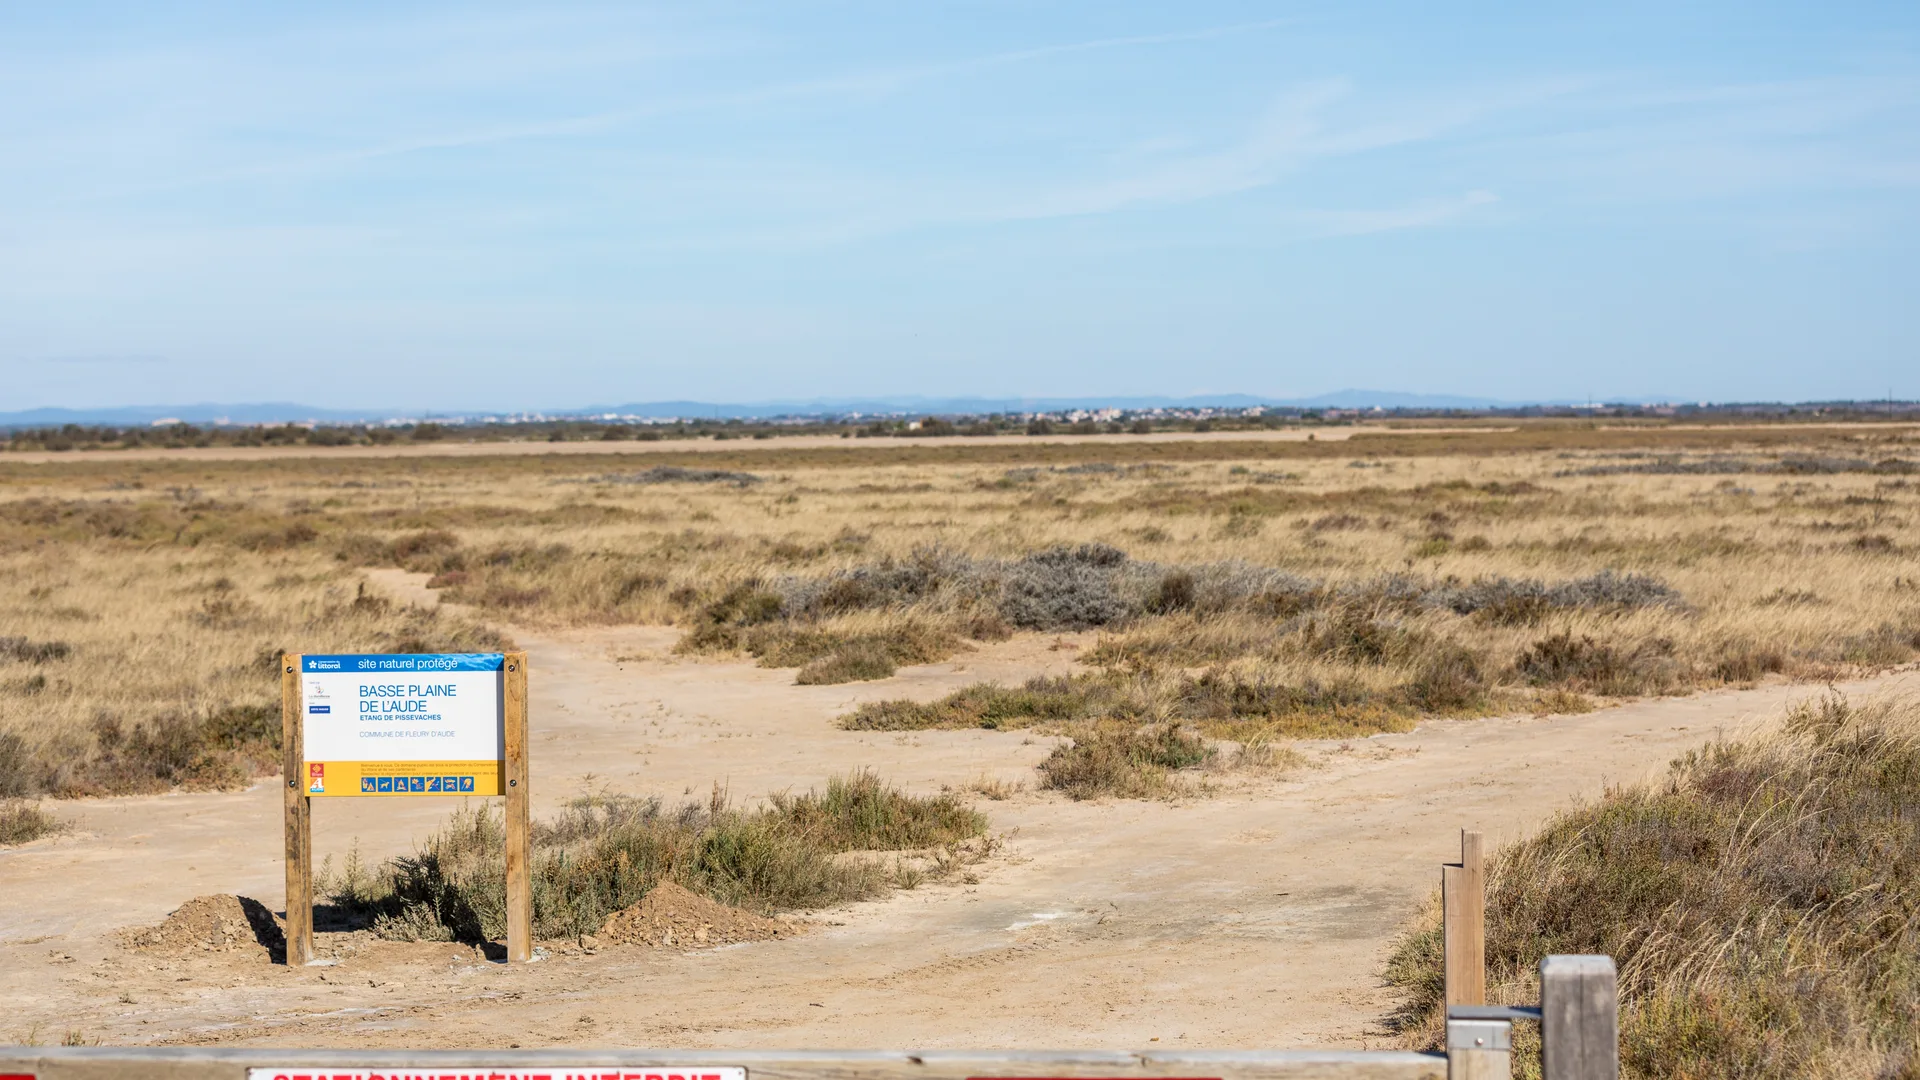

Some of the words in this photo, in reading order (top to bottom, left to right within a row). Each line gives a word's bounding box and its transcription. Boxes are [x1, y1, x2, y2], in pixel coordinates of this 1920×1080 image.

[358, 658, 376, 669] site
[380, 658, 414, 669] naturel
[418, 658, 458, 670] protégé
[360, 684, 405, 698] BASSE
[408, 684, 456, 697] PLAINE
[360, 700, 378, 712] DE
[382, 700, 427, 712] L'AUDE
